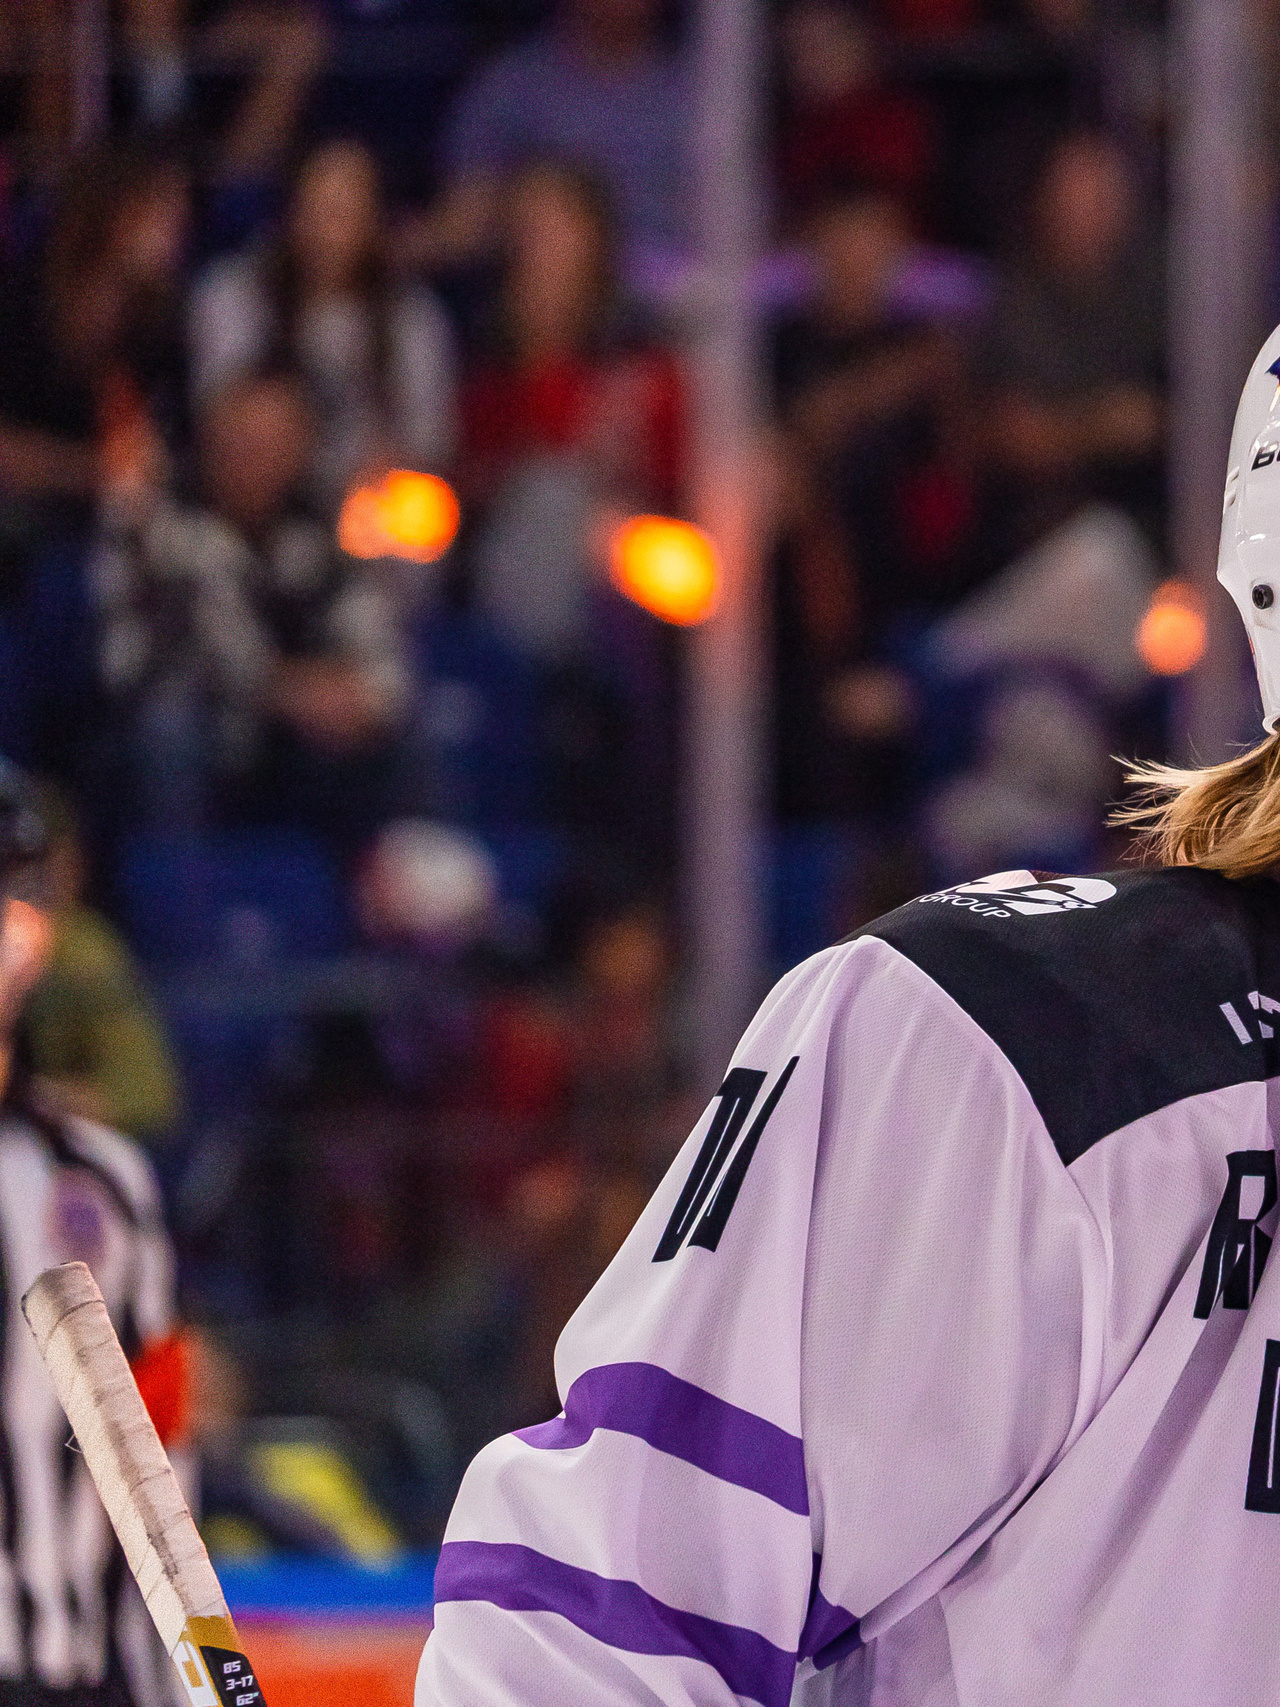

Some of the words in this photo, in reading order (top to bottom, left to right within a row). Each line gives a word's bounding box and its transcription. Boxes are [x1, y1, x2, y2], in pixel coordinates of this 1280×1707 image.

[918, 893, 1011, 918] GROUP
[223, 1660, 241, 1675] 85
[225, 1675, 254, 1691] 3-17
